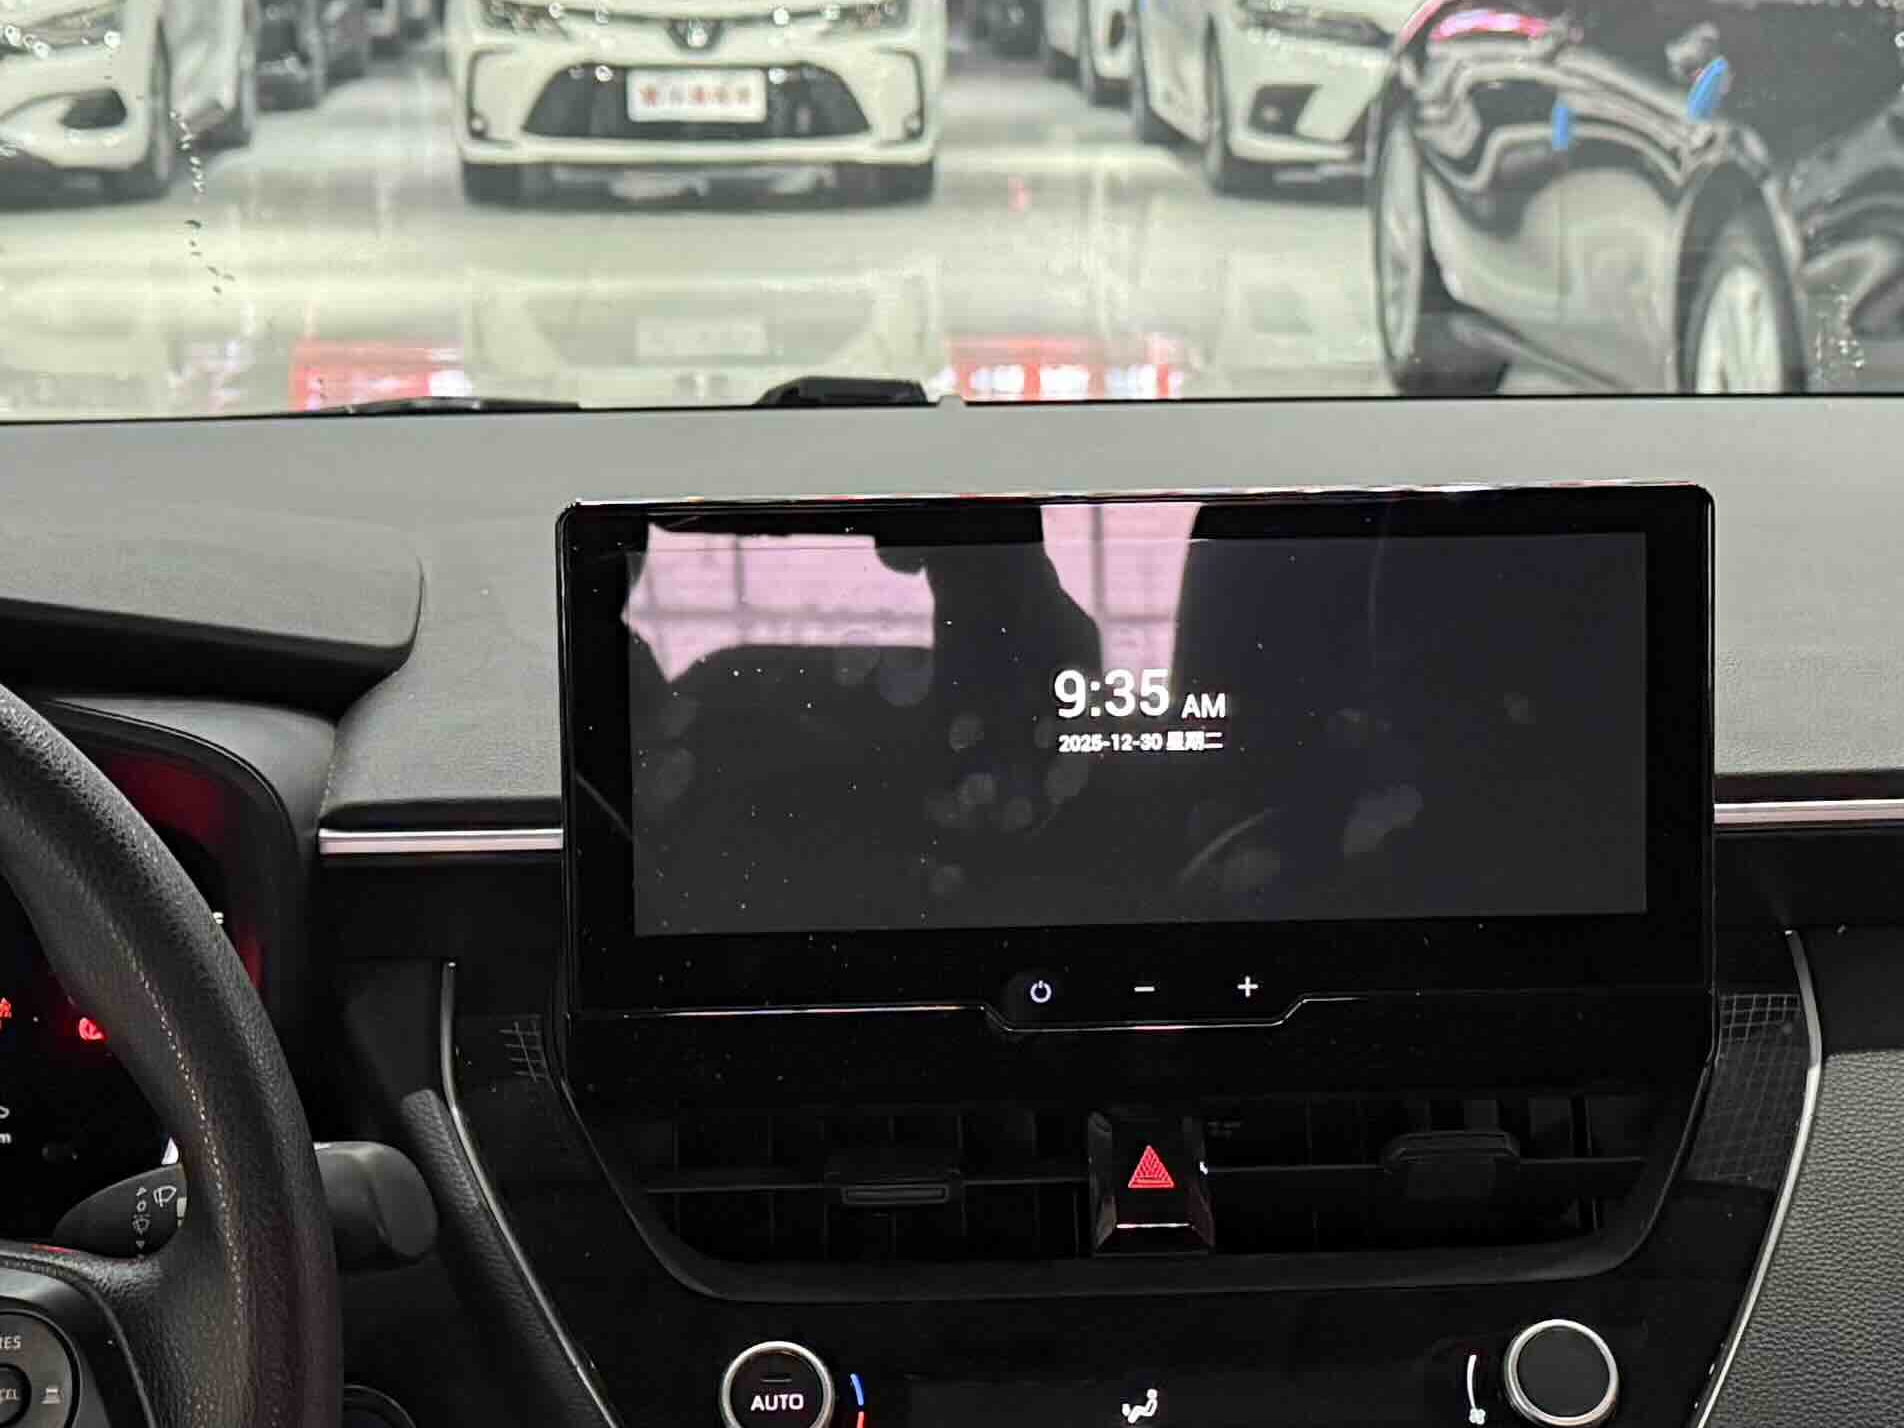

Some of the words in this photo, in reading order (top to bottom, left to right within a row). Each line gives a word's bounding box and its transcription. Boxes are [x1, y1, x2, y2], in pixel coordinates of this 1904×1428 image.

[1053, 668, 1170, 719] 9:35
[1181, 693, 1226, 719] AM
[1058, 733, 1163, 753] 2025-12-30
[750, 1394, 804, 1412] AUTO
